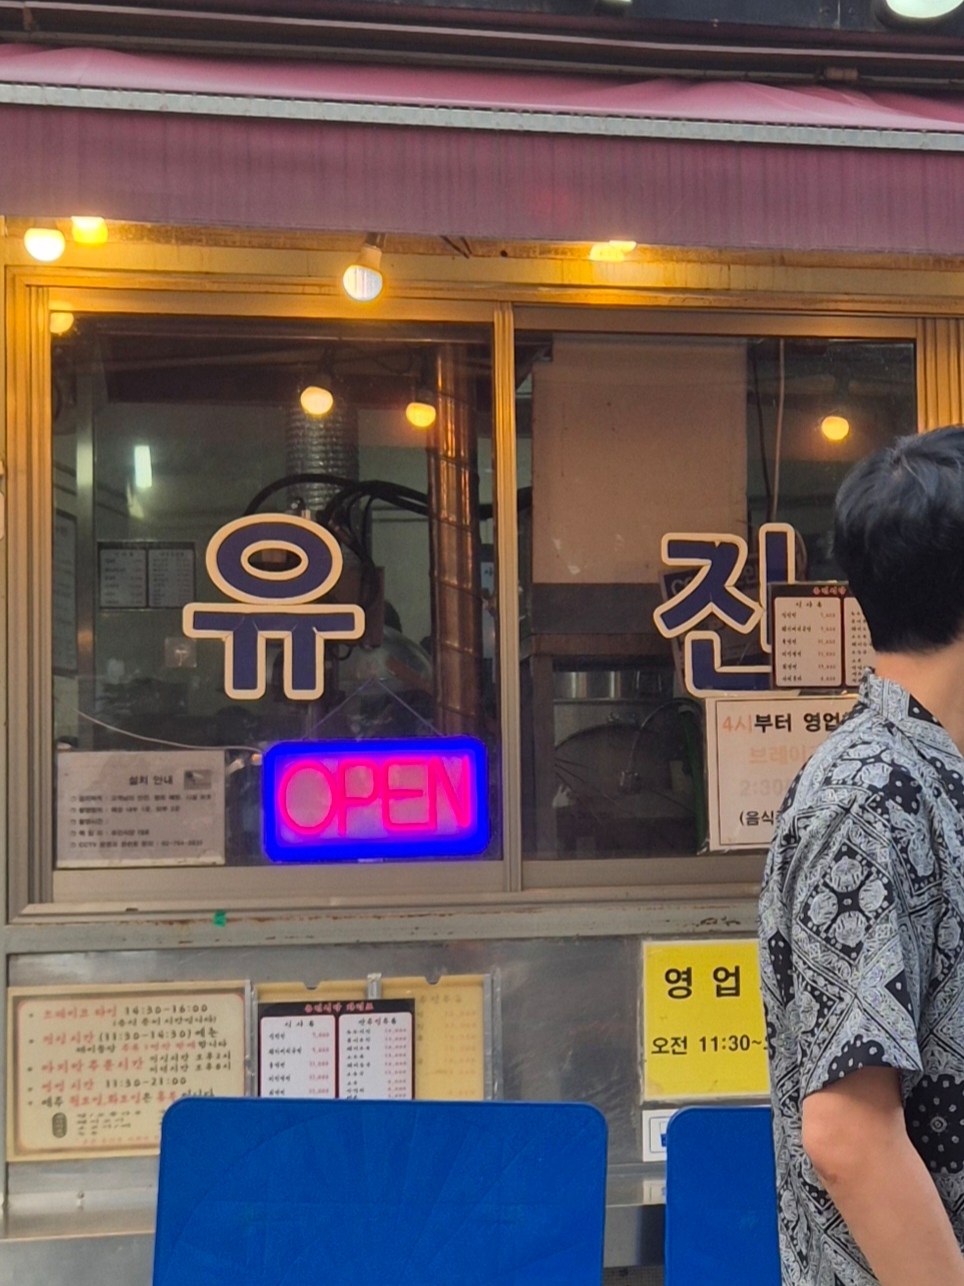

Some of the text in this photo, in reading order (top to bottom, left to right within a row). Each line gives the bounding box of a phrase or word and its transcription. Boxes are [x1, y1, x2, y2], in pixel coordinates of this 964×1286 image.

[722, 712, 848, 734] 4시부터 영업
[750, 745, 818, 764] 브레이
[279, 754, 471, 836] OPEN
[740, 810, 781, 827] (음식
[125, 1004, 208, 1016] 14:30-16:00
[650, 1034, 769, 1055] 오전 11:30~
[106, 1076, 187, 1088] 11:30-21:00
